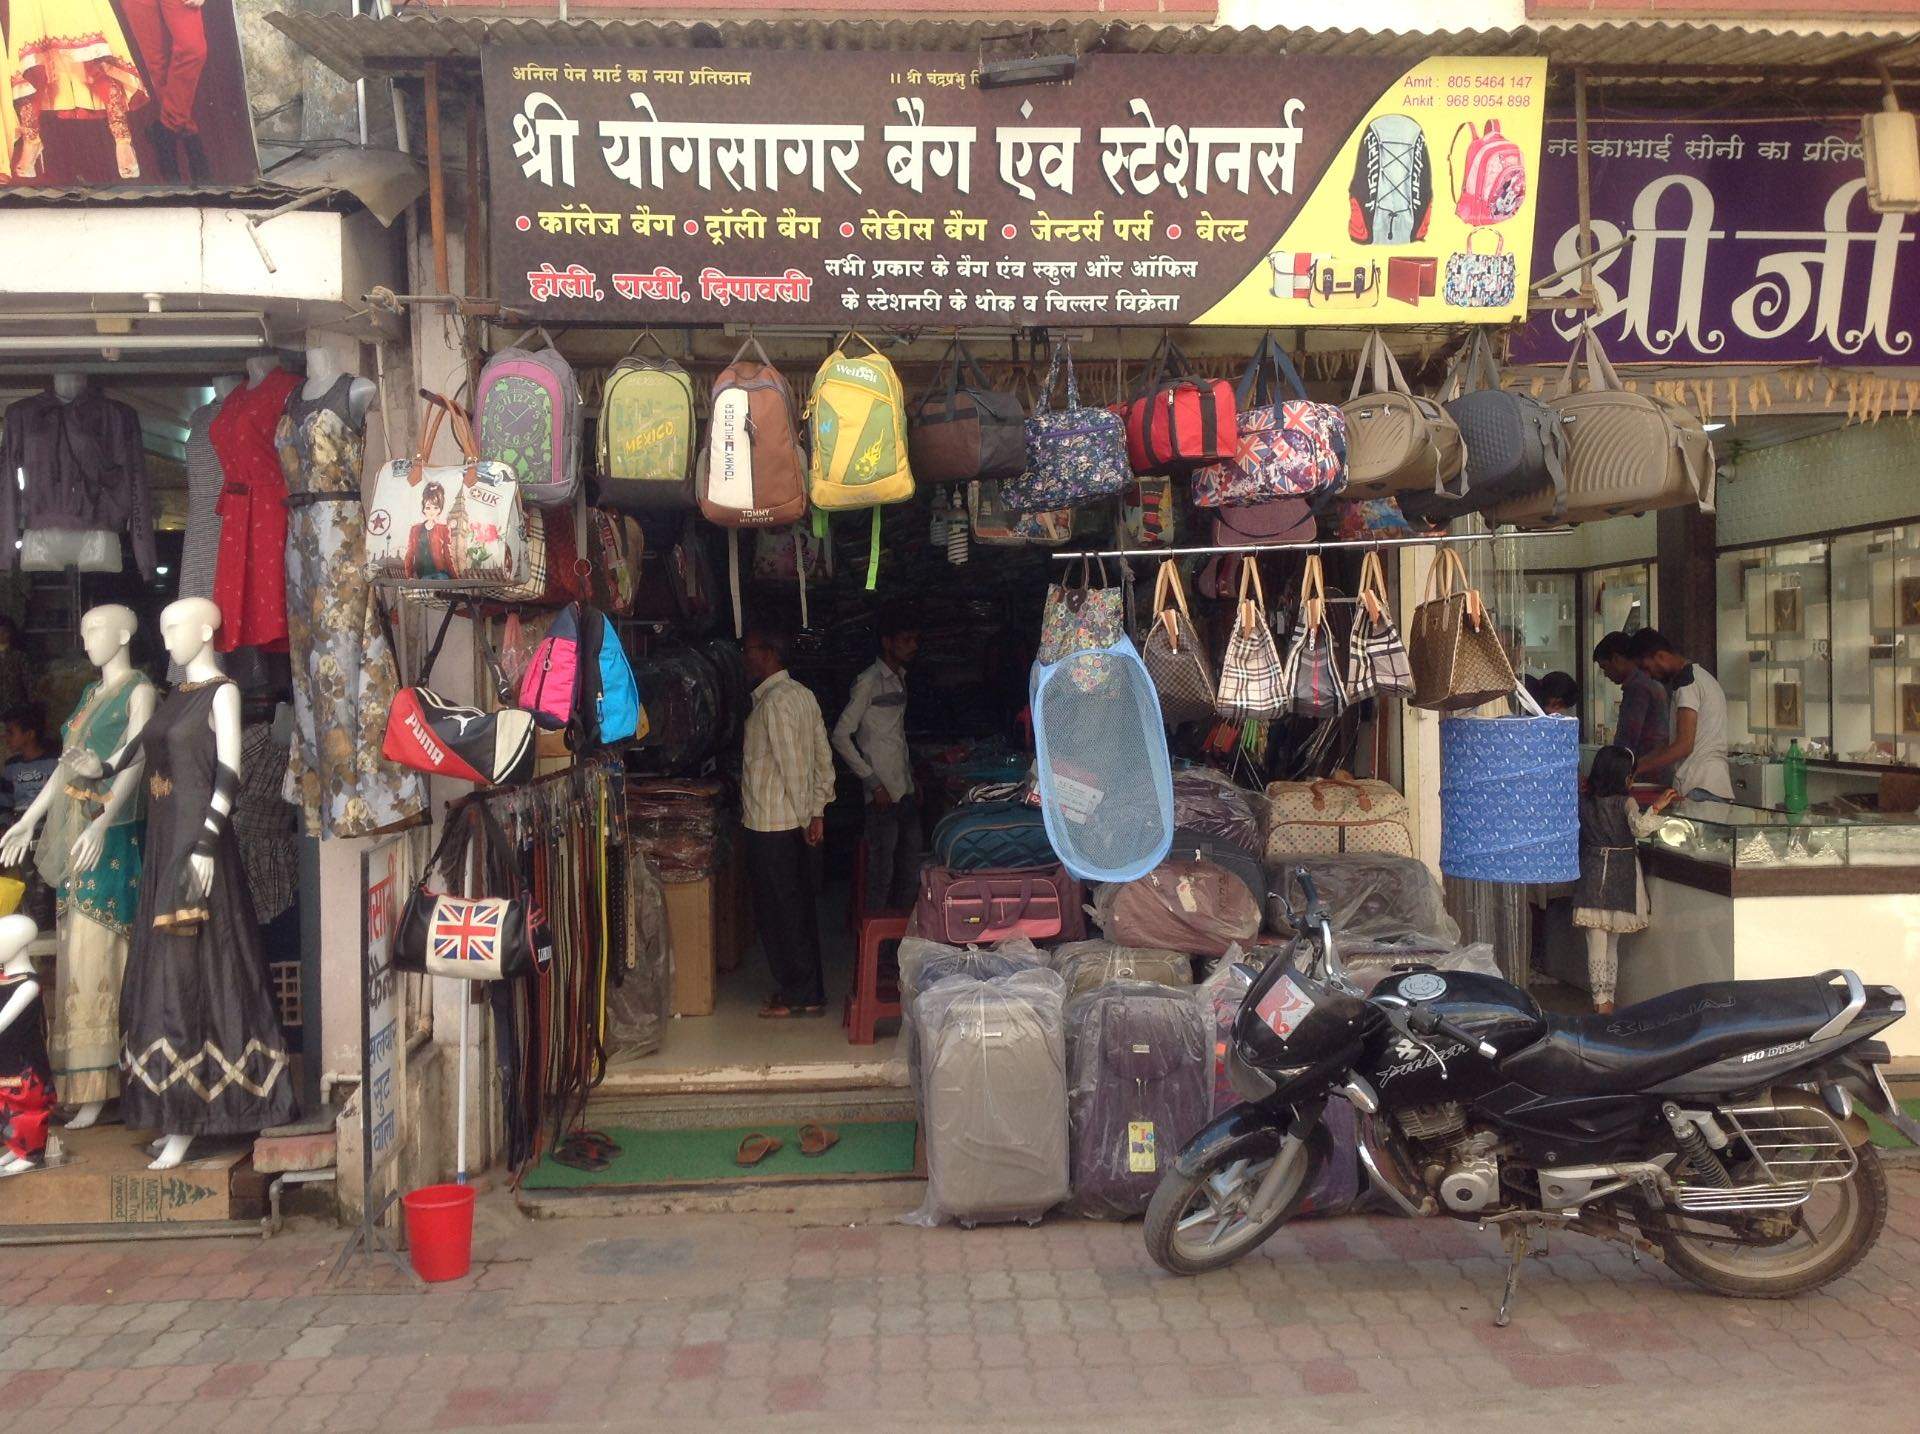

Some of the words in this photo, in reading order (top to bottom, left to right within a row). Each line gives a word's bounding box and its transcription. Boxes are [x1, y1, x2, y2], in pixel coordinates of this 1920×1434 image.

[511, 62, 559, 82] अनिल
[563, 62, 588, 83] पेन
[591, 63, 622, 83] मार्ट
[626, 69, 648, 84] का
[652, 69, 685, 85] नया
[688, 65, 753, 86] प्रतिष्ठान
[907, 68, 922, 84] श्री
[1404, 76, 1432, 88] Amit
[1447, 76, 1471, 88] 805
[1474, 76, 1505, 88] 5464
[1510, 76, 1533, 88] 147
[1402, 95, 1434, 107] Ankit
[1446, 95, 1470, 107] 968
[1472, 95, 1503, 107] 9054
[1507, 95, 1531, 107] 898
[512, 91, 580, 188] श्री
[598, 91, 865, 196] योगसागर
[883, 96, 977, 195] बैग
[1099, 97, 1306, 199] स्टेशनर्स
[1685, 134, 1745, 161] सोनी
[1758, 141, 1789, 161] का
[537, 203, 622, 236] कॉलेज
[629, 204, 676, 237] बैग
[703, 207, 768, 246] ट्रॉली
[775, 207, 822, 240] बैग
[859, 208, 935, 241] लेडीस
[943, 209, 989, 242] बैग
[1029, 209, 1105, 243] जेन्टर्स
[1112, 209, 1154, 242] पर्स
[1195, 210, 1249, 243] बेल्ट
[823, 254, 867, 277] सभी
[871, 260, 925, 280] प्रकार
[930, 253, 951, 278] के
[955, 254, 990, 278] बैग
[1032, 261, 1078, 286] स्कुल
[1084, 254, 1124, 279] और
[1130, 254, 1199, 278] ऑफिस
[1538, 174, 1725, 354] श्री
[1732, 177, 1916, 356] जी
[528, 264, 604, 302] होली,
[612, 267, 691, 303] राखी,
[699, 267, 813, 306] दिपावली
[840, 287, 860, 311] के
[866, 287, 943, 312] स्टेशनरी
[948, 288, 968, 312] के
[974, 288, 1017, 312] थोक
[1022, 295, 1039, 313] व
[1044, 287, 1109, 313] चिल्लर
[1114, 288, 1181, 314] विक्रेता
[624, 420, 675, 457] MEXICO
[725, 452, 735, 481] TOMMY
[742, 509, 770, 518] TOMMY
[404, 711, 445, 766] PUMA
[1741, 1050, 1765, 1064] 150
